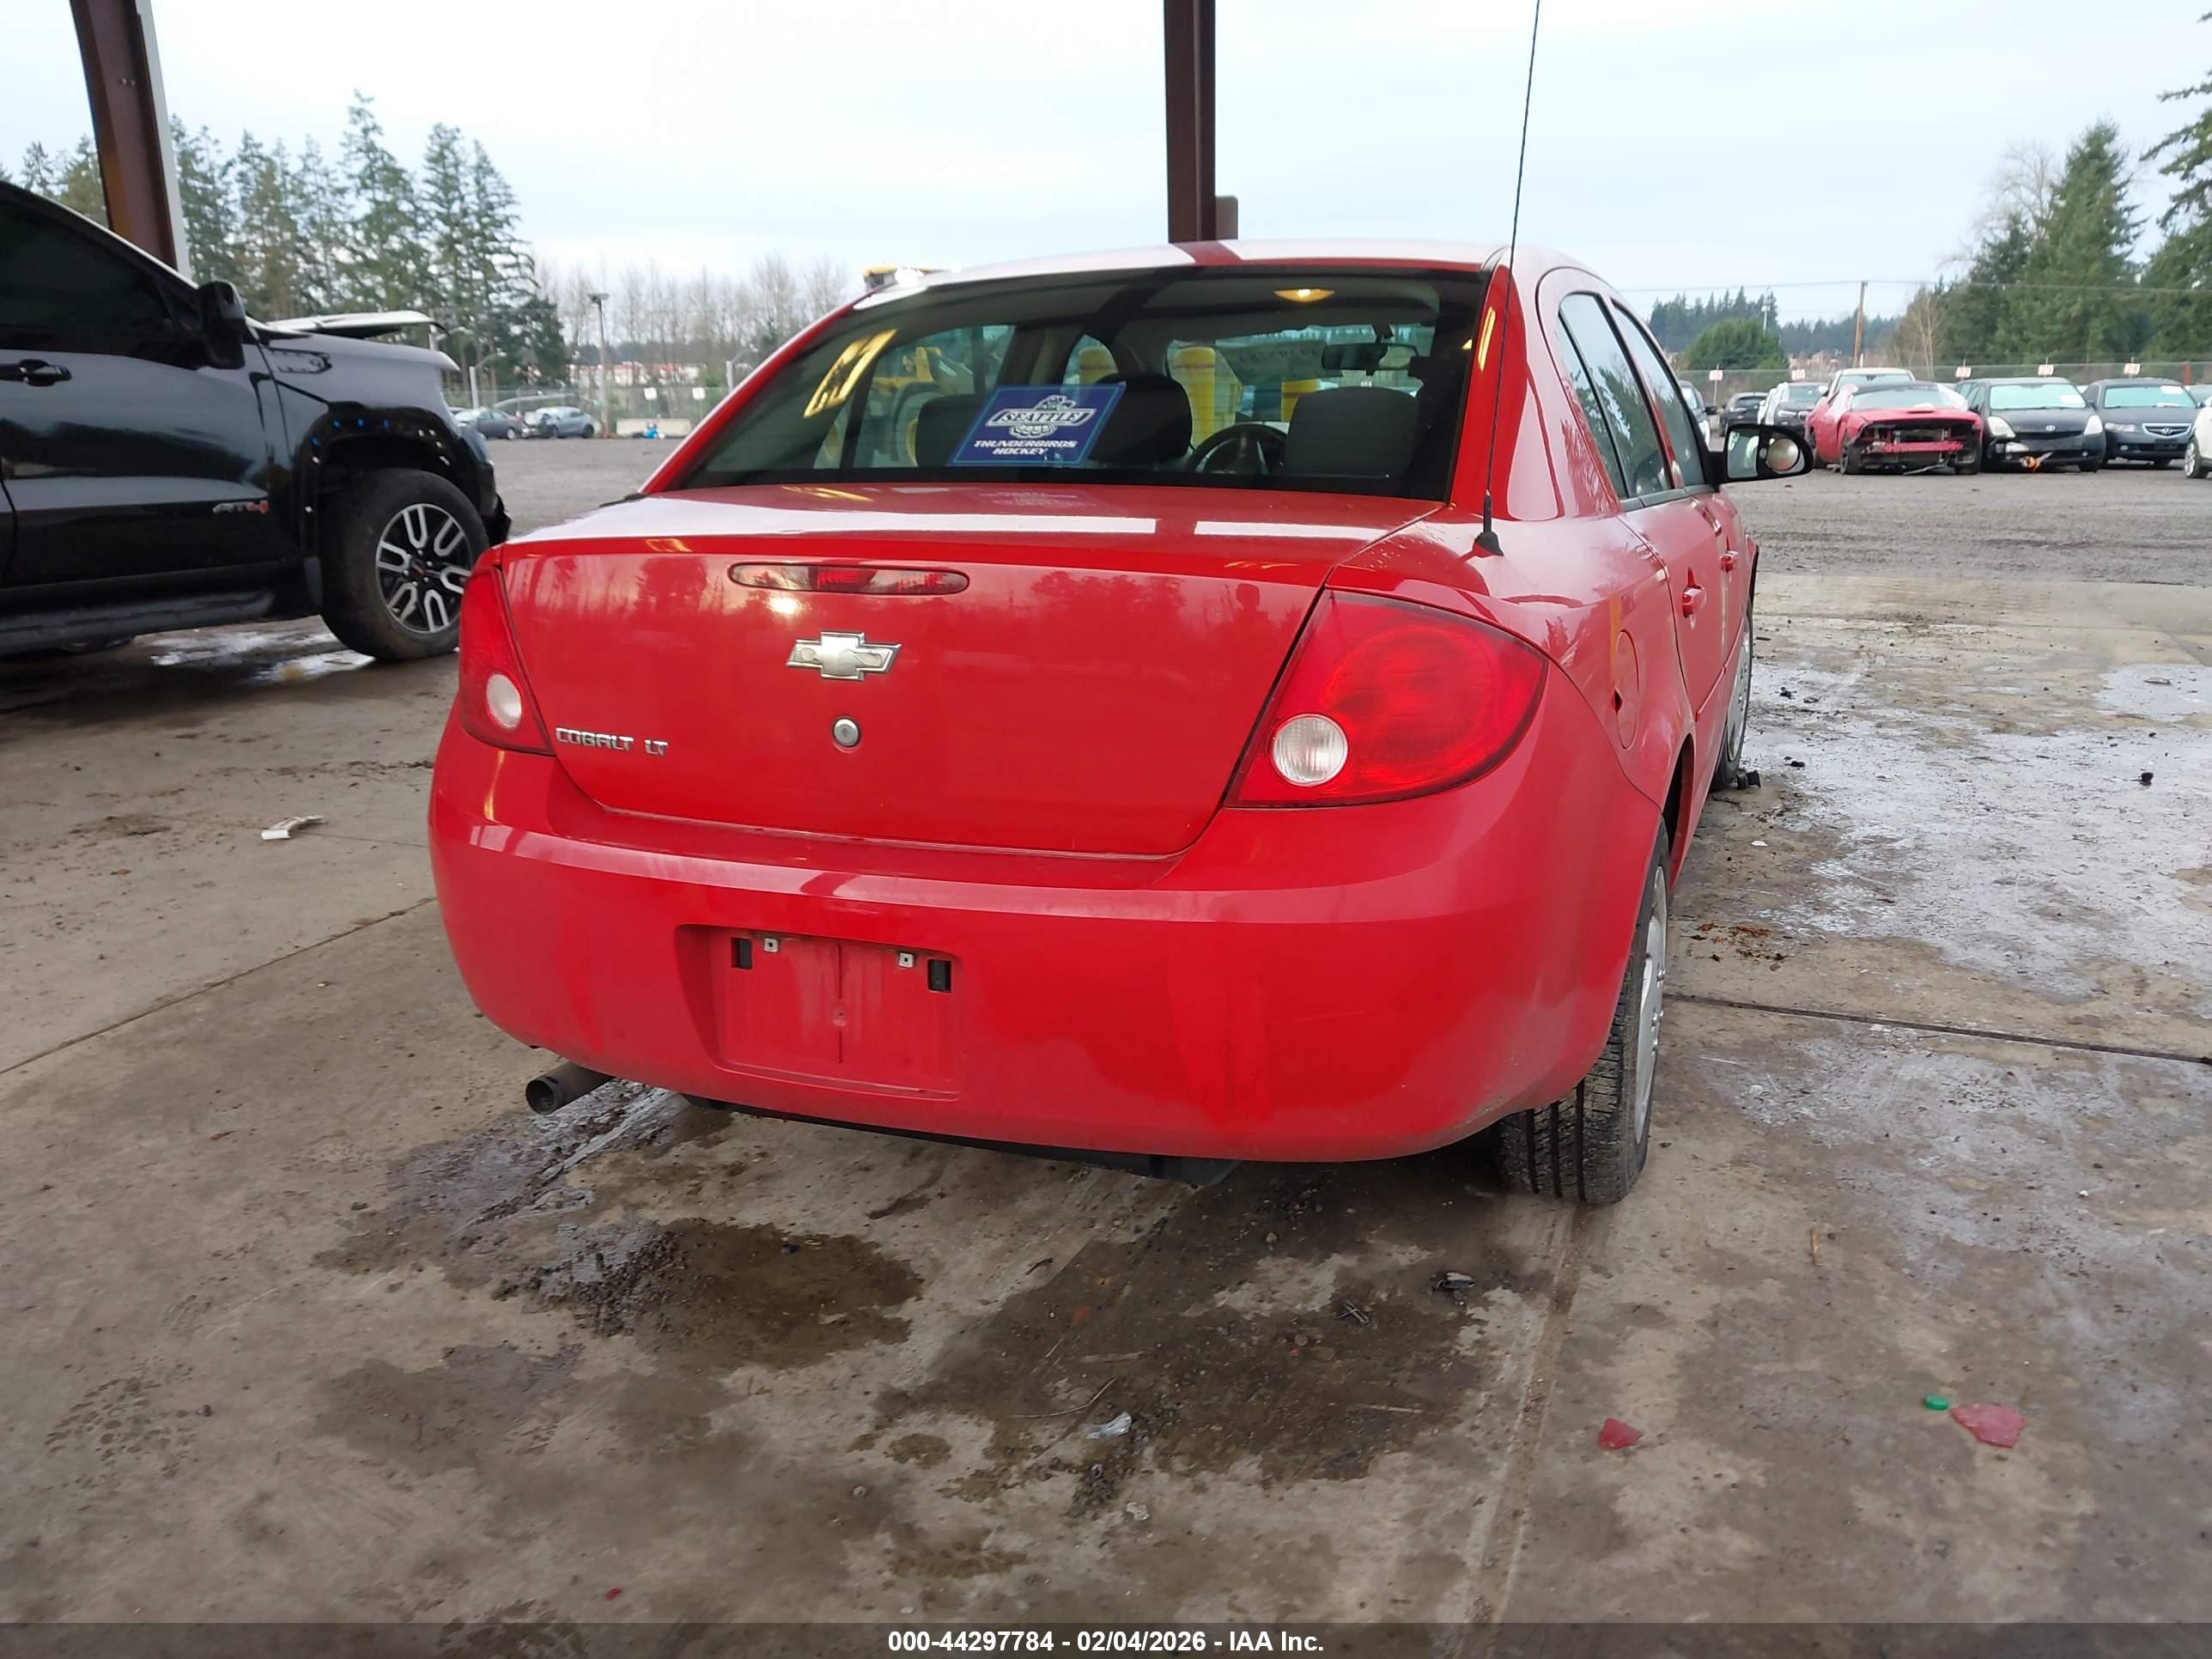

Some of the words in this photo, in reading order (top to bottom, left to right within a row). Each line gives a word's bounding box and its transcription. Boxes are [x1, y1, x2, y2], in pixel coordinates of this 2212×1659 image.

[999, 410, 1082, 423] SEATTLE
[974, 440, 1079, 448] THUNDERBIRDS
[556, 727, 634, 751] COBALT
[644, 739, 668, 757] LT
